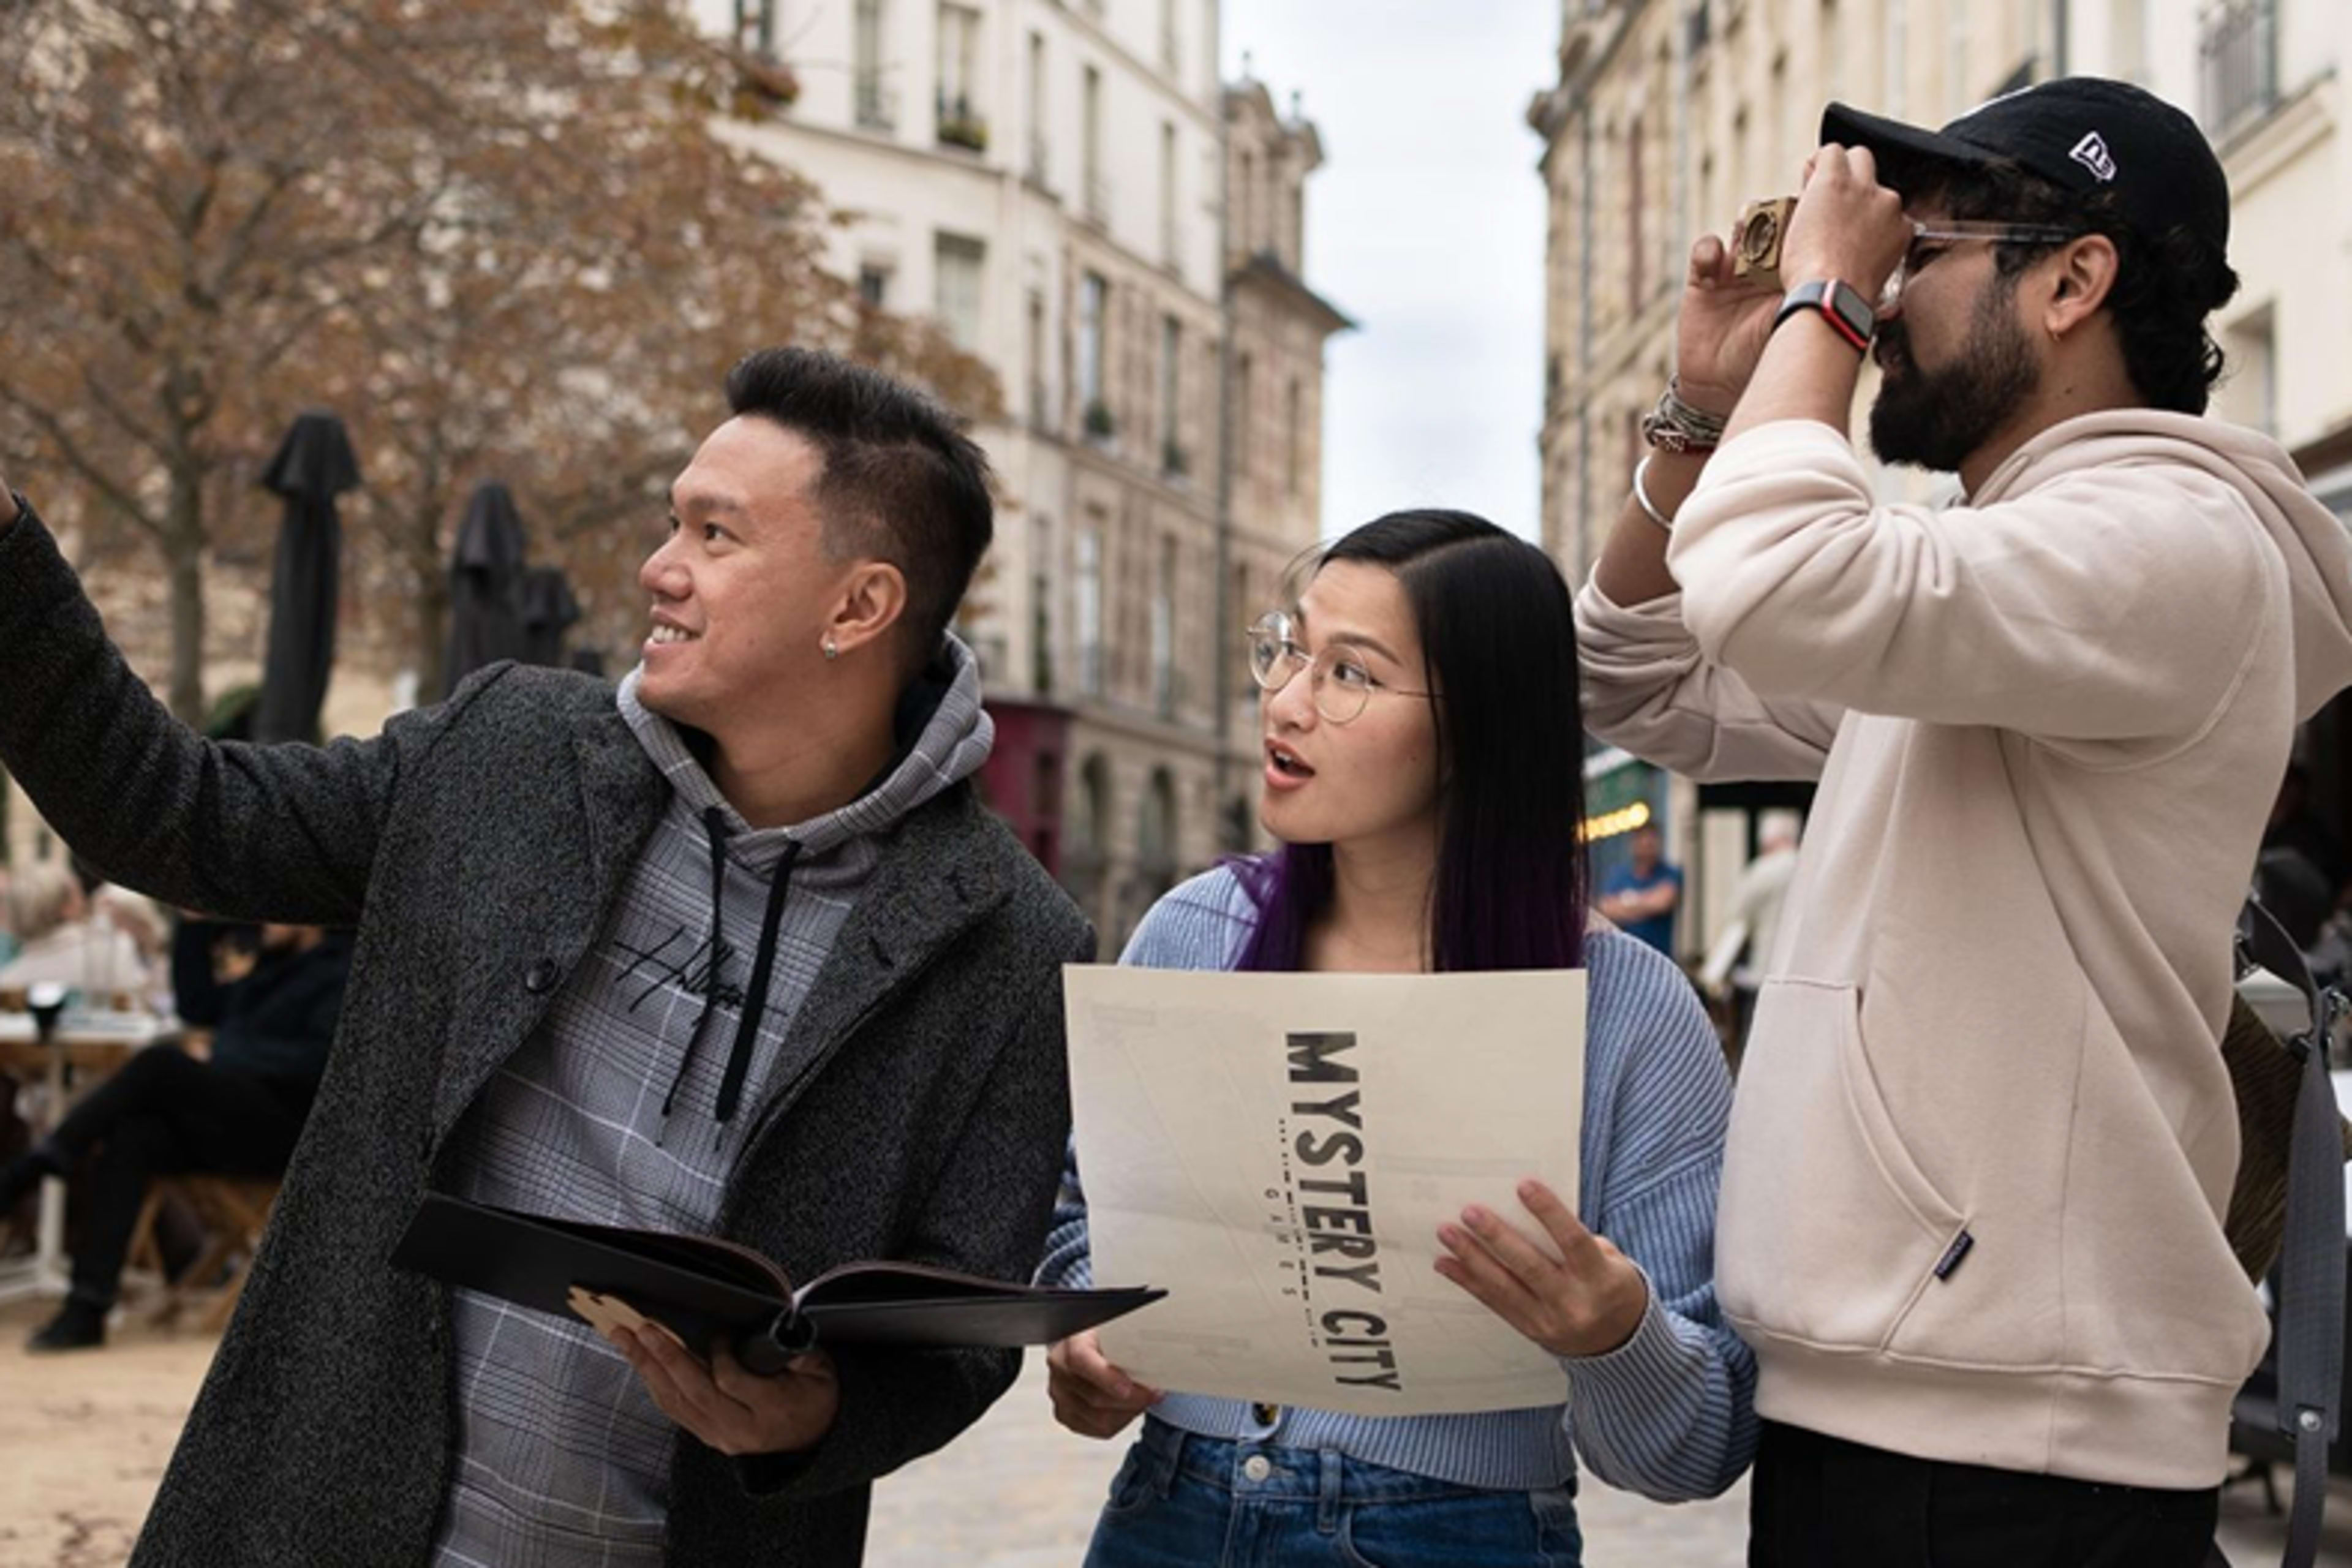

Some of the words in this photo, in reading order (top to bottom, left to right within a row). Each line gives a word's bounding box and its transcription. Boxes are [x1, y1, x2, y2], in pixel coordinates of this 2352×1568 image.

[1285, 1031, 1382, 1293] MYSTERY
[1264, 1187, 1297, 1296] GAMES
[1319, 1309, 1403, 1392] CITY
